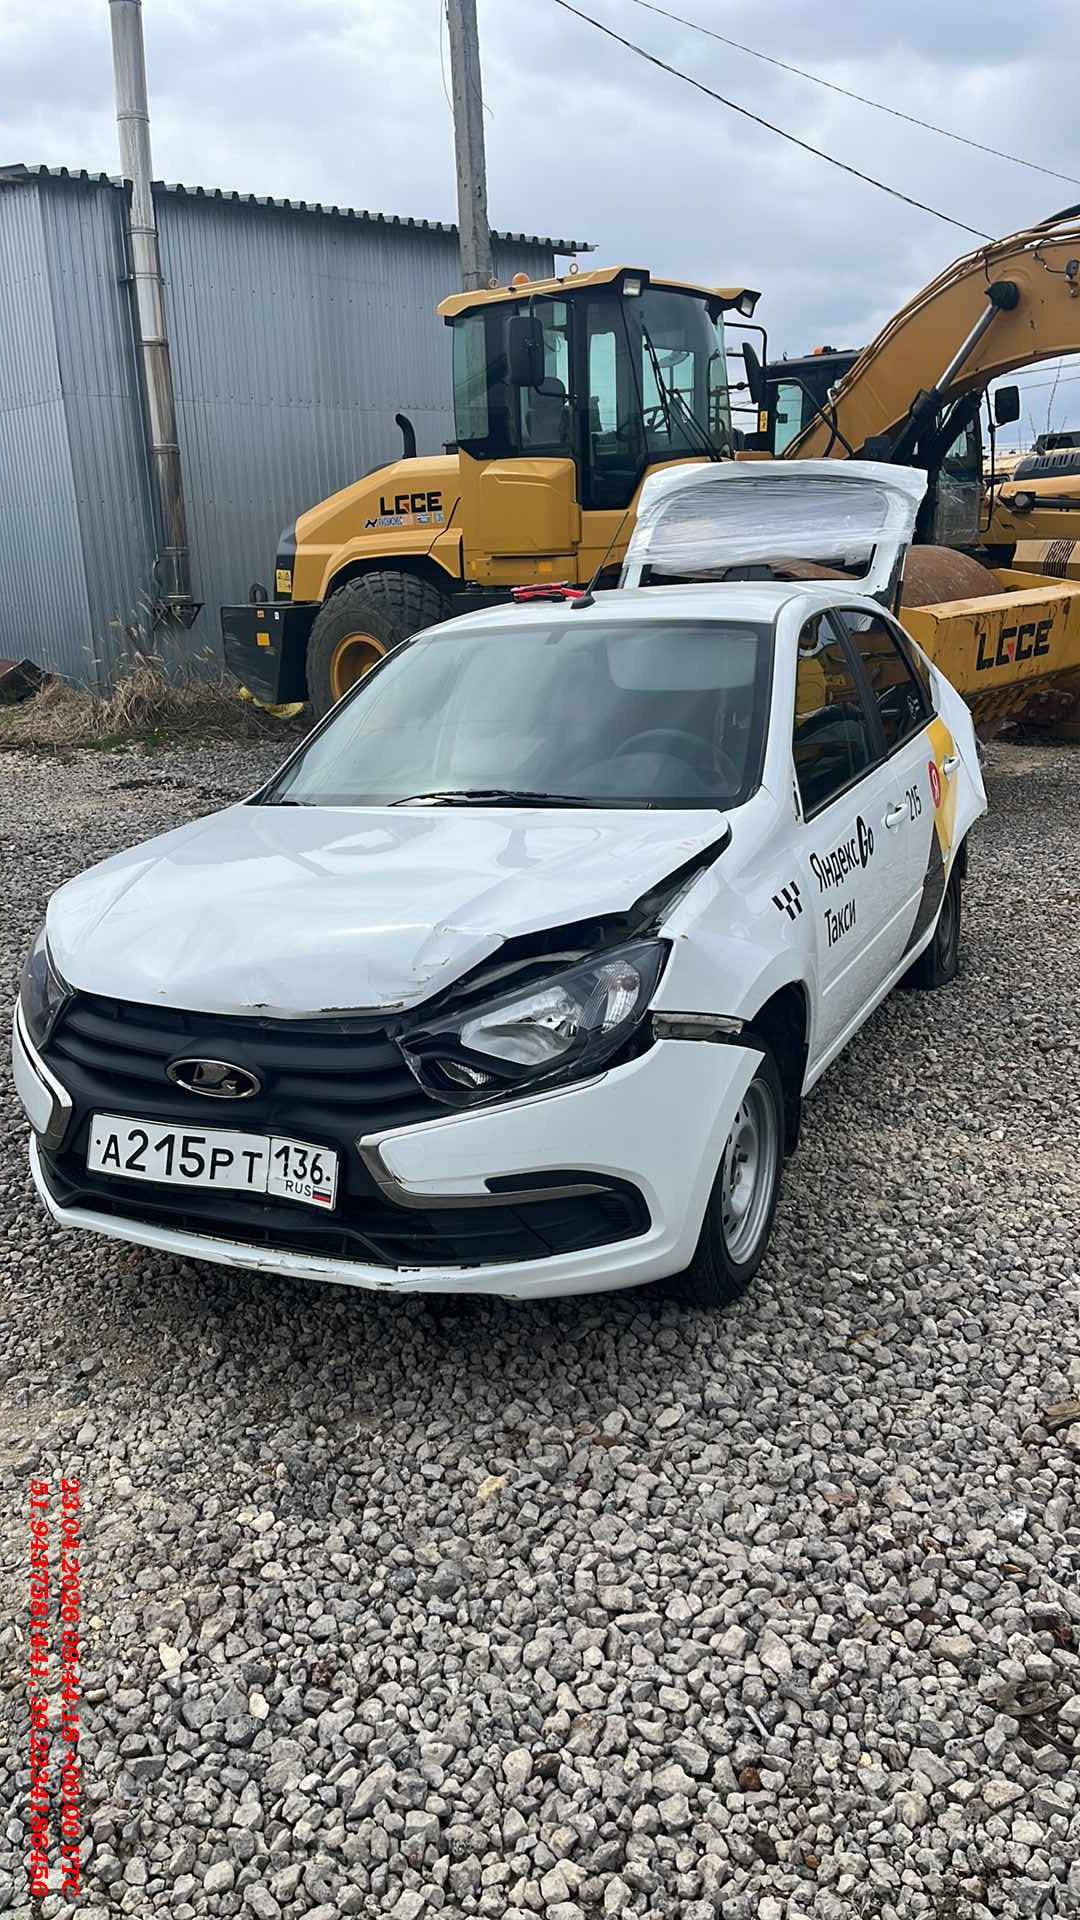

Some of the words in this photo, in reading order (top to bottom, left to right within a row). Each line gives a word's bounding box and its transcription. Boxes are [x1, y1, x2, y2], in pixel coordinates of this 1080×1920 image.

[906, 785, 922, 821] 215
[809, 837, 860, 893] Яндекс
[824, 899, 856, 947] Такси
[274, 1145, 324, 1185] 136
[285, 1179, 312, 1198] RUS
